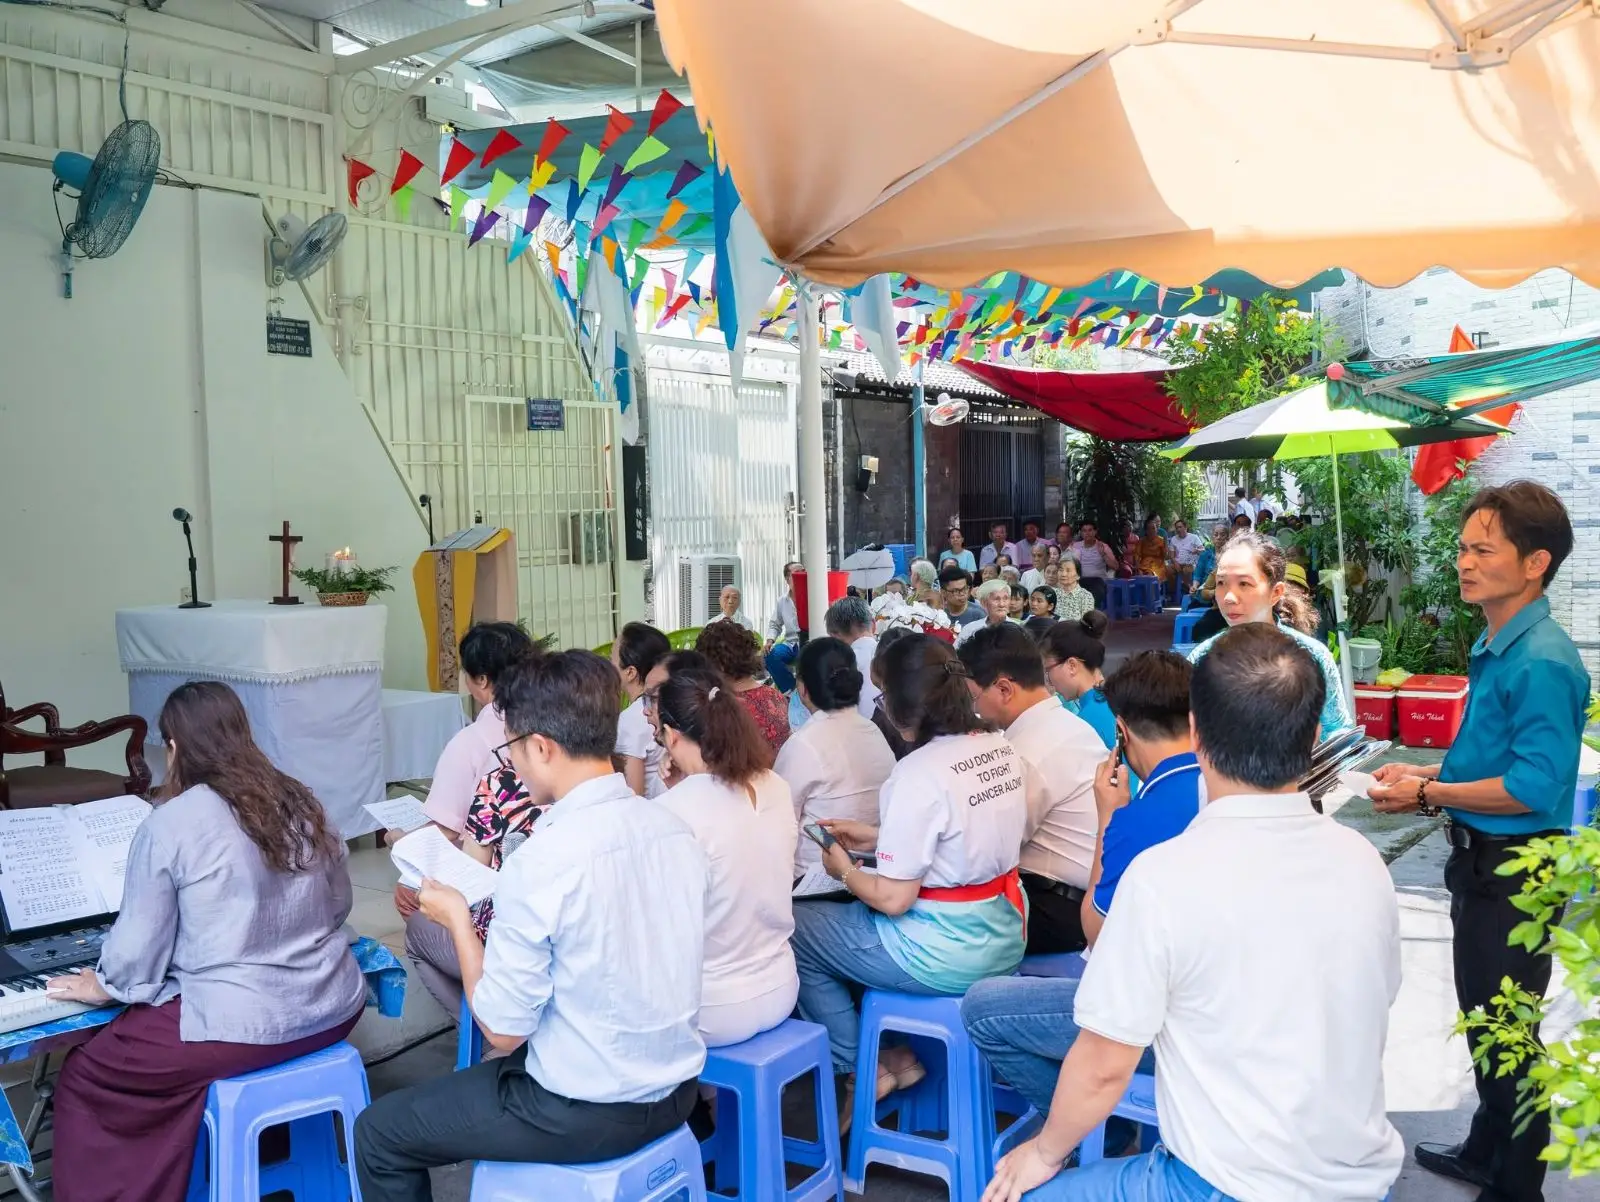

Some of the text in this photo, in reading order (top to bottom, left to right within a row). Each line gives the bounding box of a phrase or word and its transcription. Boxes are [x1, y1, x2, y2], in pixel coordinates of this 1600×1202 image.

[950, 758, 975, 775] YOU
[973, 749, 1000, 767] DON'T
[976, 763, 1012, 783] TO FIGHT
[968, 784, 1005, 806] CANCER
